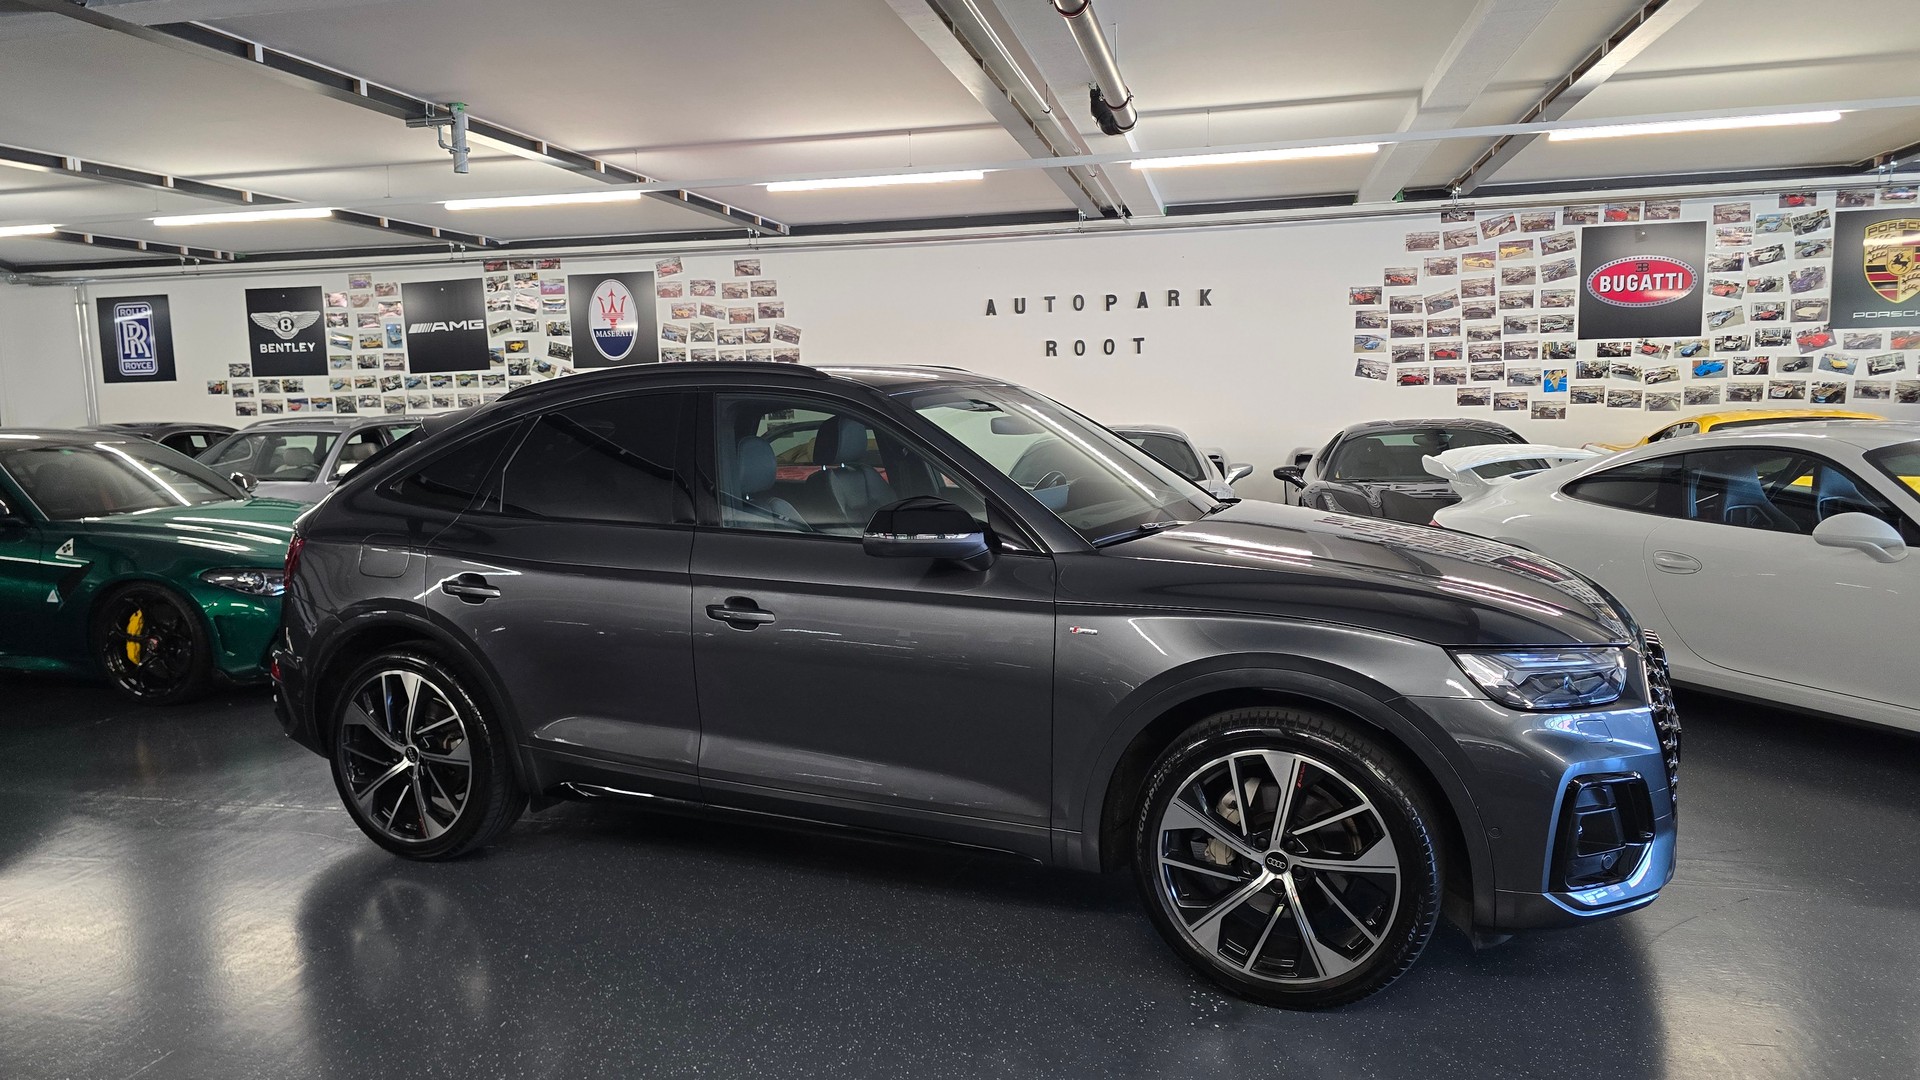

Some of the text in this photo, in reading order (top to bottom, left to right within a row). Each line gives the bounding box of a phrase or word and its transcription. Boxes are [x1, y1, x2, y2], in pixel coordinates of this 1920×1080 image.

[1599, 272, 1684, 293] BUGATTI
[985, 289, 1212, 316] AUTOPARK
[120, 307, 147, 317] ROLLS
[431, 319, 485, 333] AMG
[595, 330, 633, 338] MASERATI
[260, 342, 316, 353] BENTLEY
[1045, 337, 1145, 357] ROOT
[124, 361, 153, 370] ROYCE
